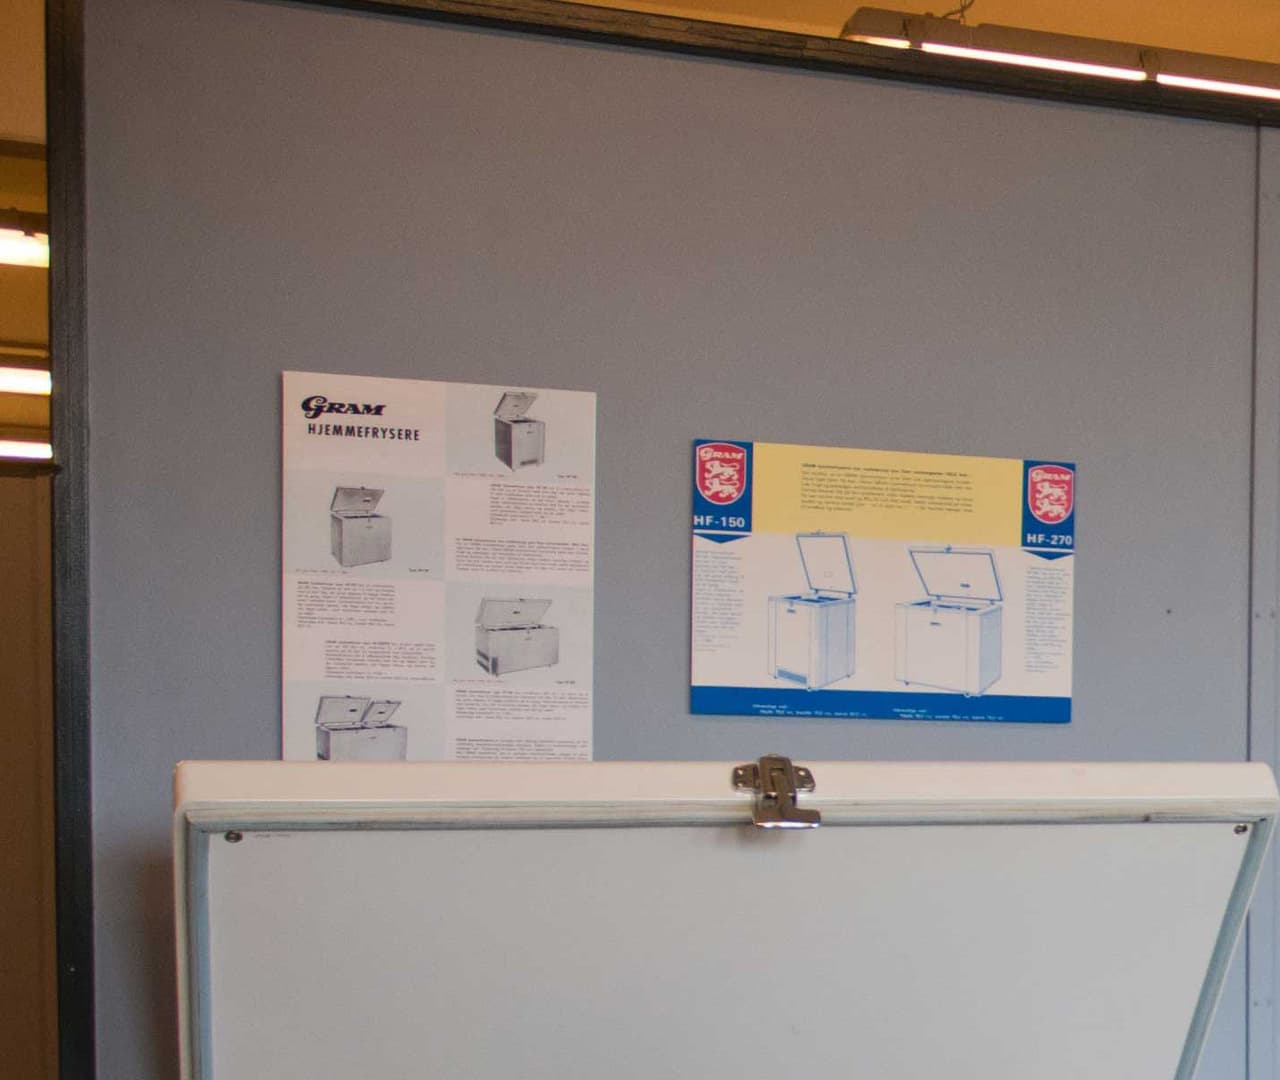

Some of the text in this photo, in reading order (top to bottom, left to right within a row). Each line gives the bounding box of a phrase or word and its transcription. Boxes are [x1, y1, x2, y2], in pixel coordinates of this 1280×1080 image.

[301, 395, 387, 419] GRAM
[308, 423, 420, 441] HJEMMEFRYSERE
[693, 515, 746, 528] HF-150
[1026, 533, 1073, 546] HF-270
